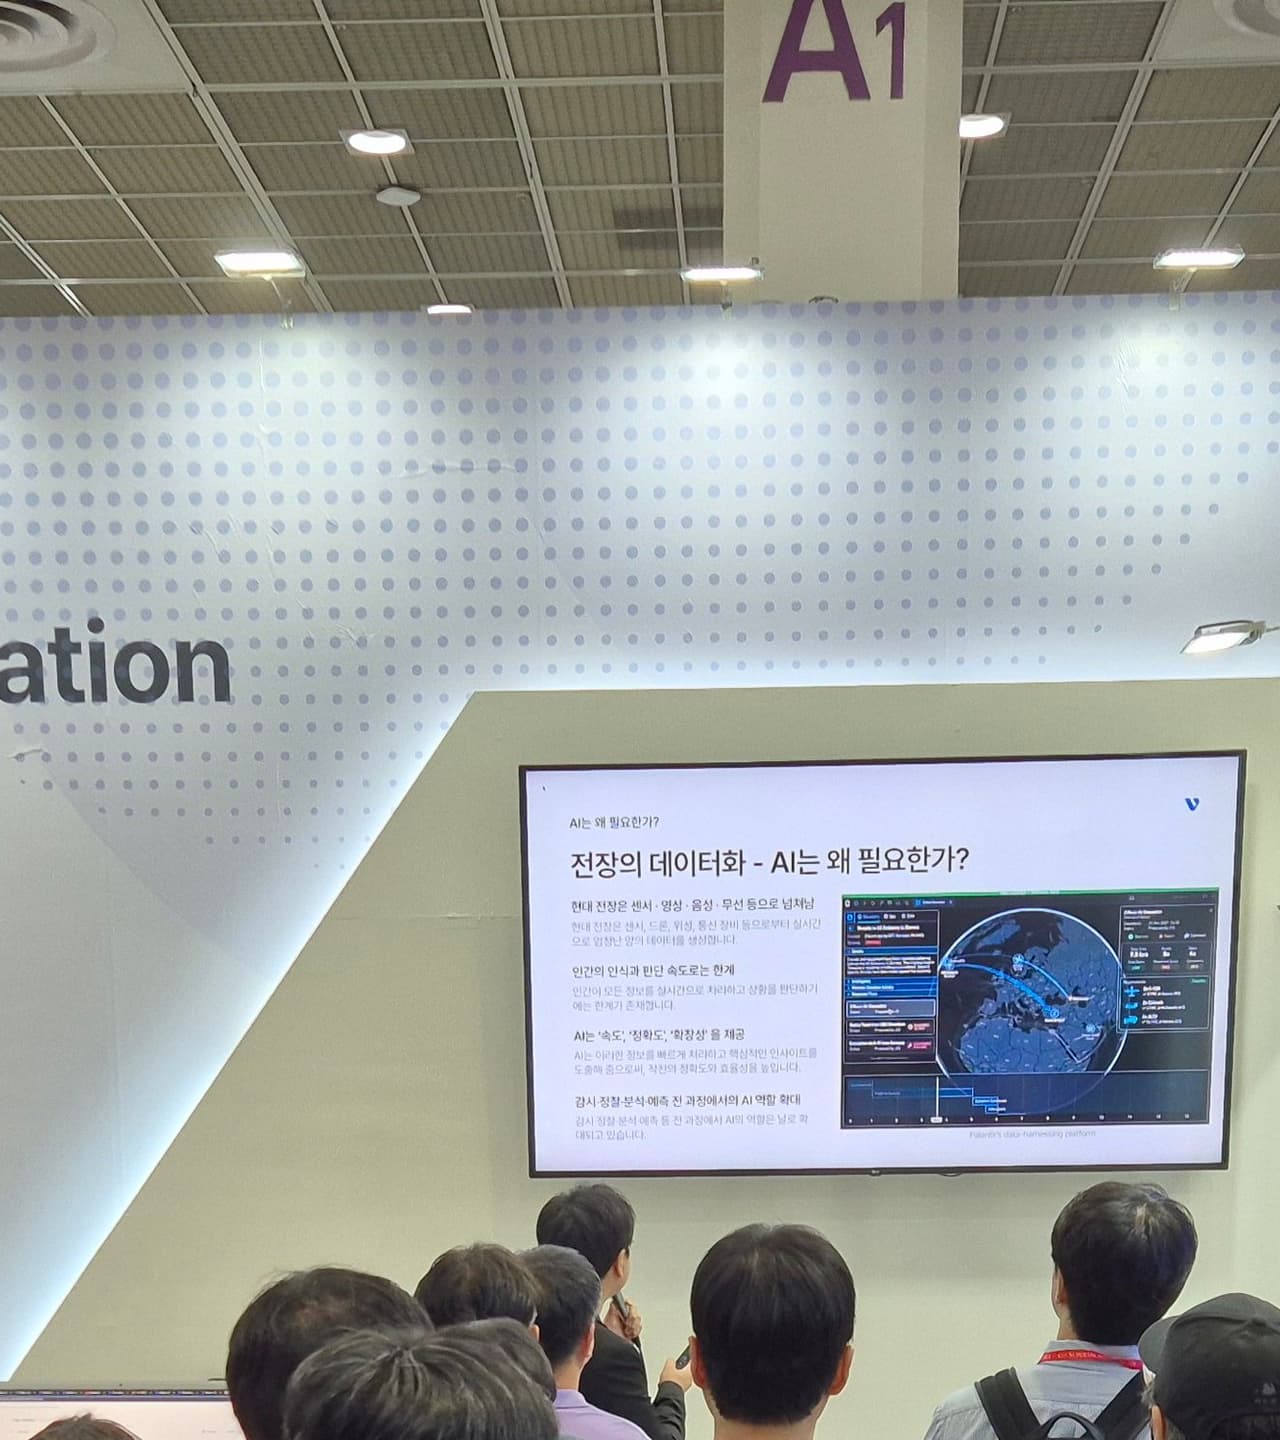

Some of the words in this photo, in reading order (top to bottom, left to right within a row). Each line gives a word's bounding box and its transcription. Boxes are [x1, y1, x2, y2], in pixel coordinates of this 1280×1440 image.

[762, 0, 905, 102] A1
[569, 816, 592, 829] AI는
[595, 816, 606, 829] 왜
[609, 815, 660, 829] 필요한가?
[571, 850, 642, 879] 전장의
[650, 849, 747, 878] 데이터화
[770, 849, 820, 875] AI는
[827, 847, 851, 875] 왜
[858, 845, 970, 874] 필요한가?
[571, 900, 593, 913] 현대
[596, 901, 627, 912] 전장은
[631, 899, 652, 912] 센서
[692, 898, 713, 911] 음성
[722, 898, 744, 911] 무선
[747, 898, 779, 911] 등으로
[667, 964, 710, 977] 속도로는
